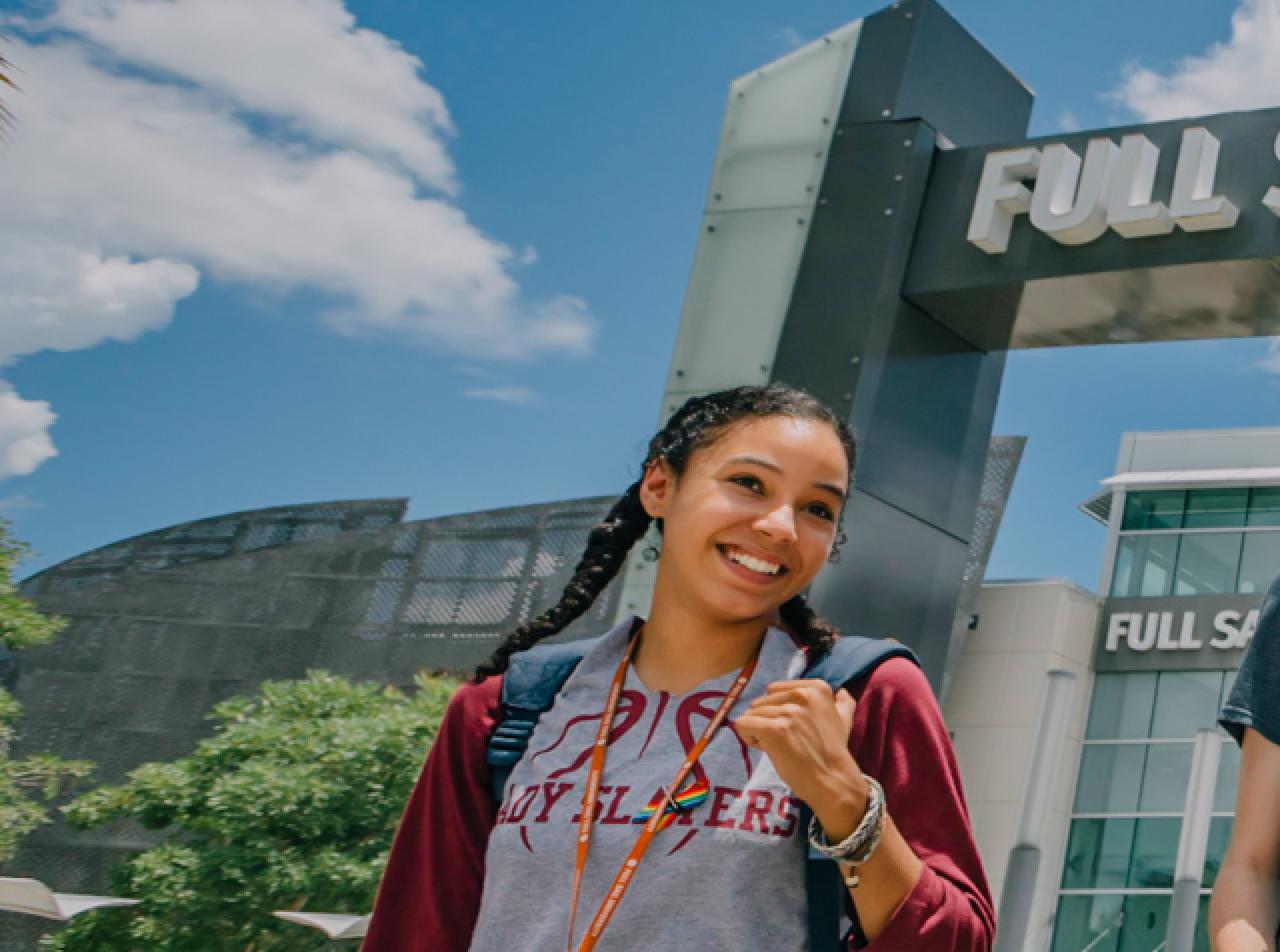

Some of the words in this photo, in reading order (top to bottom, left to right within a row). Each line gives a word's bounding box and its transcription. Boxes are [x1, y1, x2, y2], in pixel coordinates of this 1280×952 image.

[967, 127, 1240, 254] FULL
[1105, 611, 1202, 651] FULL
[1209, 609, 1261, 649] SA
[496, 781, 575, 824] ADY
